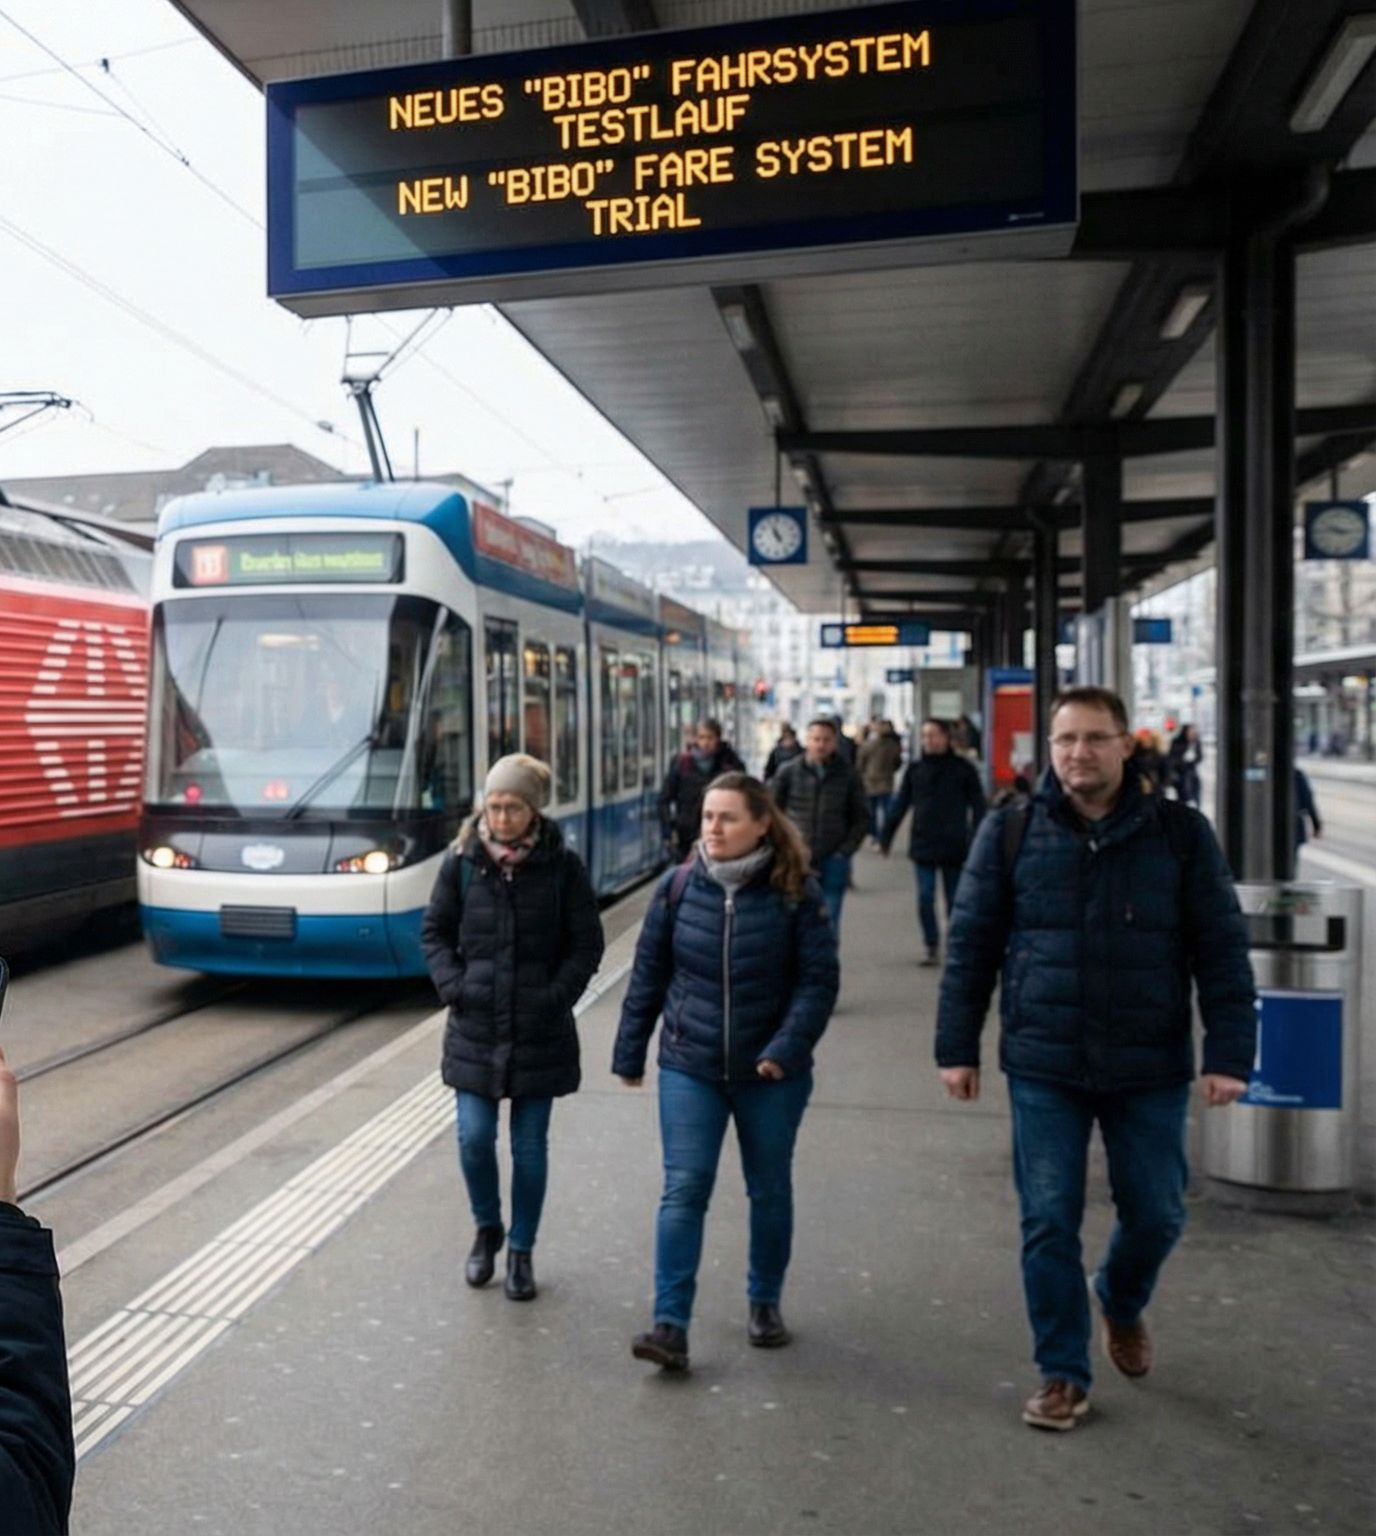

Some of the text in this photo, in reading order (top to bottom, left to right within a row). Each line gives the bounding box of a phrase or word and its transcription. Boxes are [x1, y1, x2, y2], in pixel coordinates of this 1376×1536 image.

[390, 31, 929, 129] NEUES "BIBO" FAHRSYSTEM
[553, 94, 750, 149] TESTLAUF
[399, 127, 912, 213] NEW "BIBO" FARE SYSTEM
[586, 193, 701, 235] TRIAL
